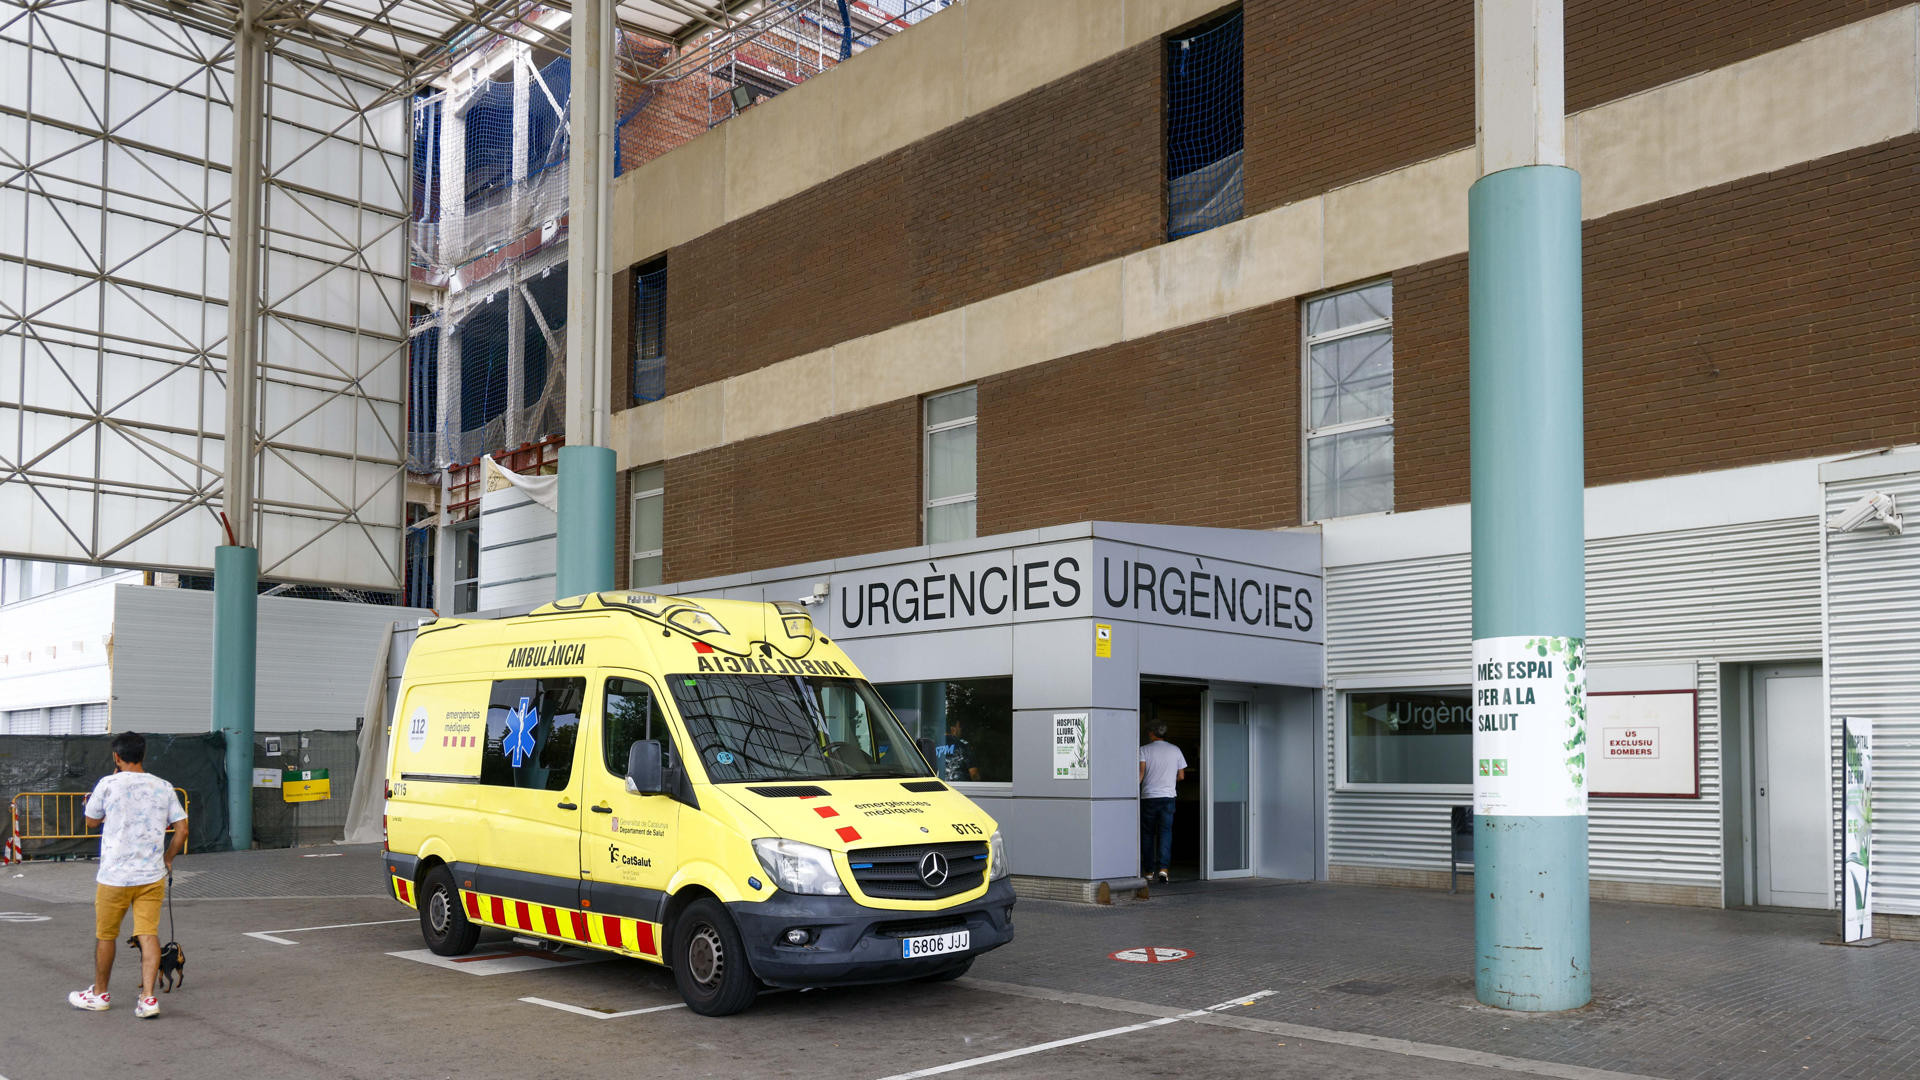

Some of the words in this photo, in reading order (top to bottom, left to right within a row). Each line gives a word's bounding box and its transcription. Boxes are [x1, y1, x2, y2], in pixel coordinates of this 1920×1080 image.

[842, 557, 1081, 629] URGÈNCIES
[1103, 557, 1313, 632] URGÈNCIES
[507, 640, 586, 668] AMBULÀNCIA
[1477, 658, 1503, 681] MÉS
[1507, 661, 1552, 679] ESPAI
[1478, 688, 1499, 706] PER
[1502, 688, 1512, 705] A
[1516, 687, 1536, 705] LA
[411, 718, 426, 734] 112
[1056, 718, 1081, 727] HOSPITAL
[1478, 713, 1518, 732] SALUT
[1056, 736, 1063, 744] DE
[1064, 736, 1075, 744] FUM
[394, 783, 407, 796] 8715
[620, 826, 645, 836] Departament
[952, 823, 983, 835] 8715
[622, 855, 652, 867] CatSalut
[912, 937, 944, 954] 6806
[948, 933, 968, 950] JJJ
